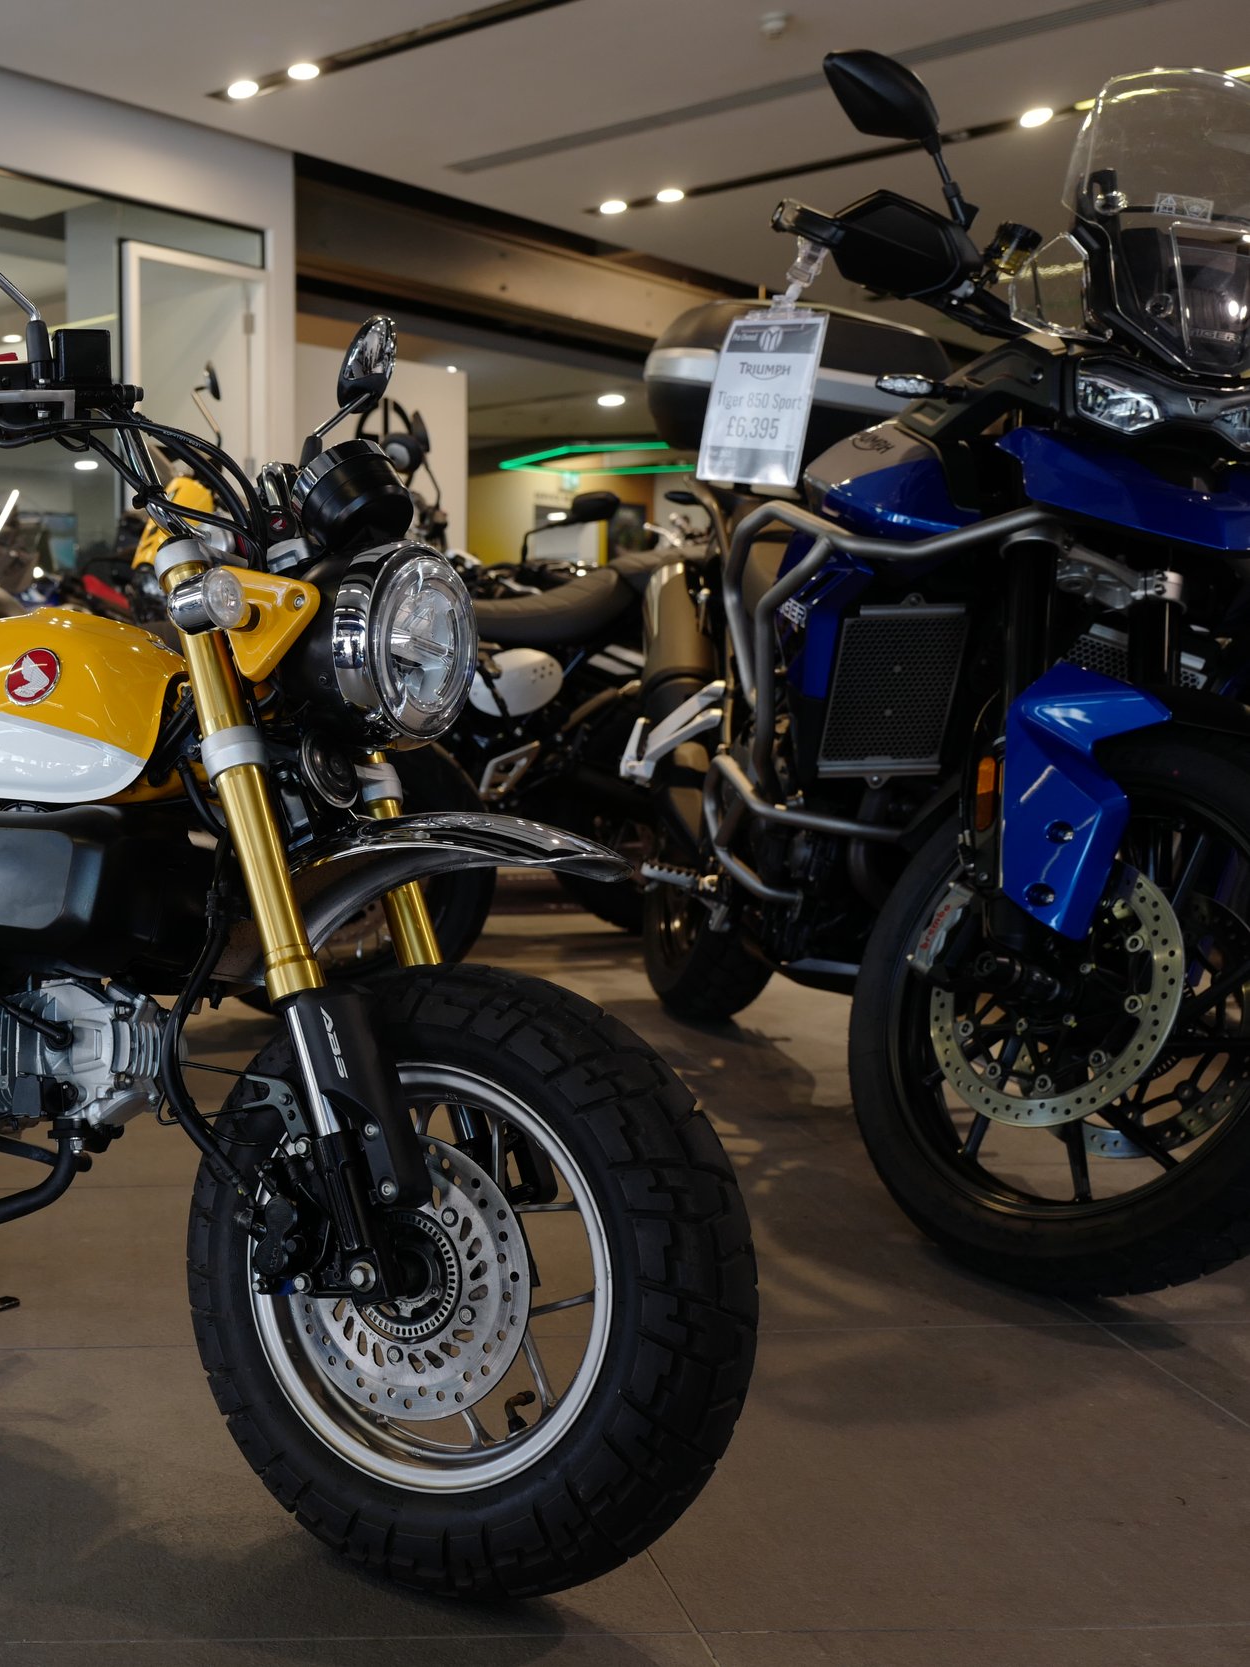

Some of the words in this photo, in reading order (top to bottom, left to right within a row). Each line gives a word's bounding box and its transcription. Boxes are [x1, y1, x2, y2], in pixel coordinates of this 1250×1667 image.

[739, 361, 791, 380] TRIUMPH
[717, 391, 743, 410] Tiger
[746, 392, 770, 409] 850
[772, 393, 803, 412] Sport
[725, 416, 780, 440] £6,395
[319, 1005, 349, 1080] ABS
